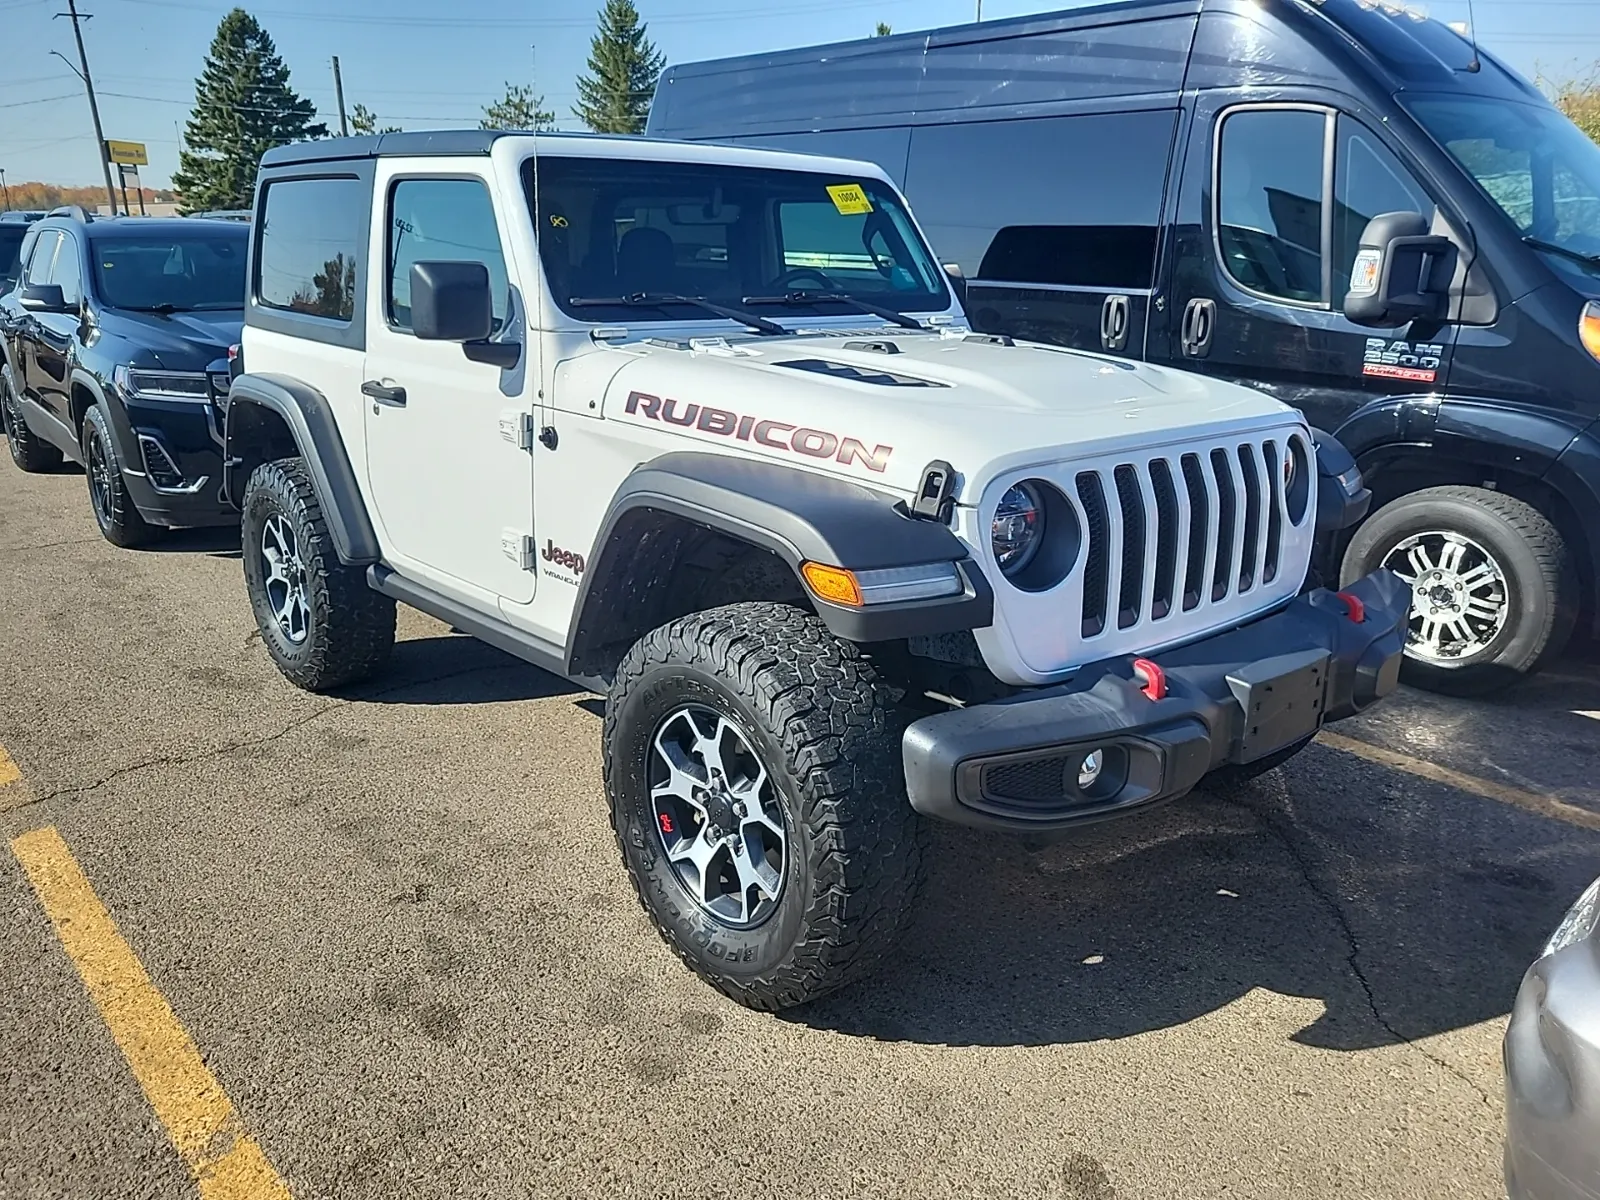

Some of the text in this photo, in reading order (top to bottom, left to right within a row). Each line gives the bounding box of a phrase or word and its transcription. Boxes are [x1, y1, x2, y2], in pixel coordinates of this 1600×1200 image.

[1366, 338, 1443, 356] RAM
[1364, 351, 1440, 368] 2500
[625, 391, 893, 473] RUBICON
[541, 538, 584, 576] Jeep
[543, 567, 580, 588] WRANGLE
